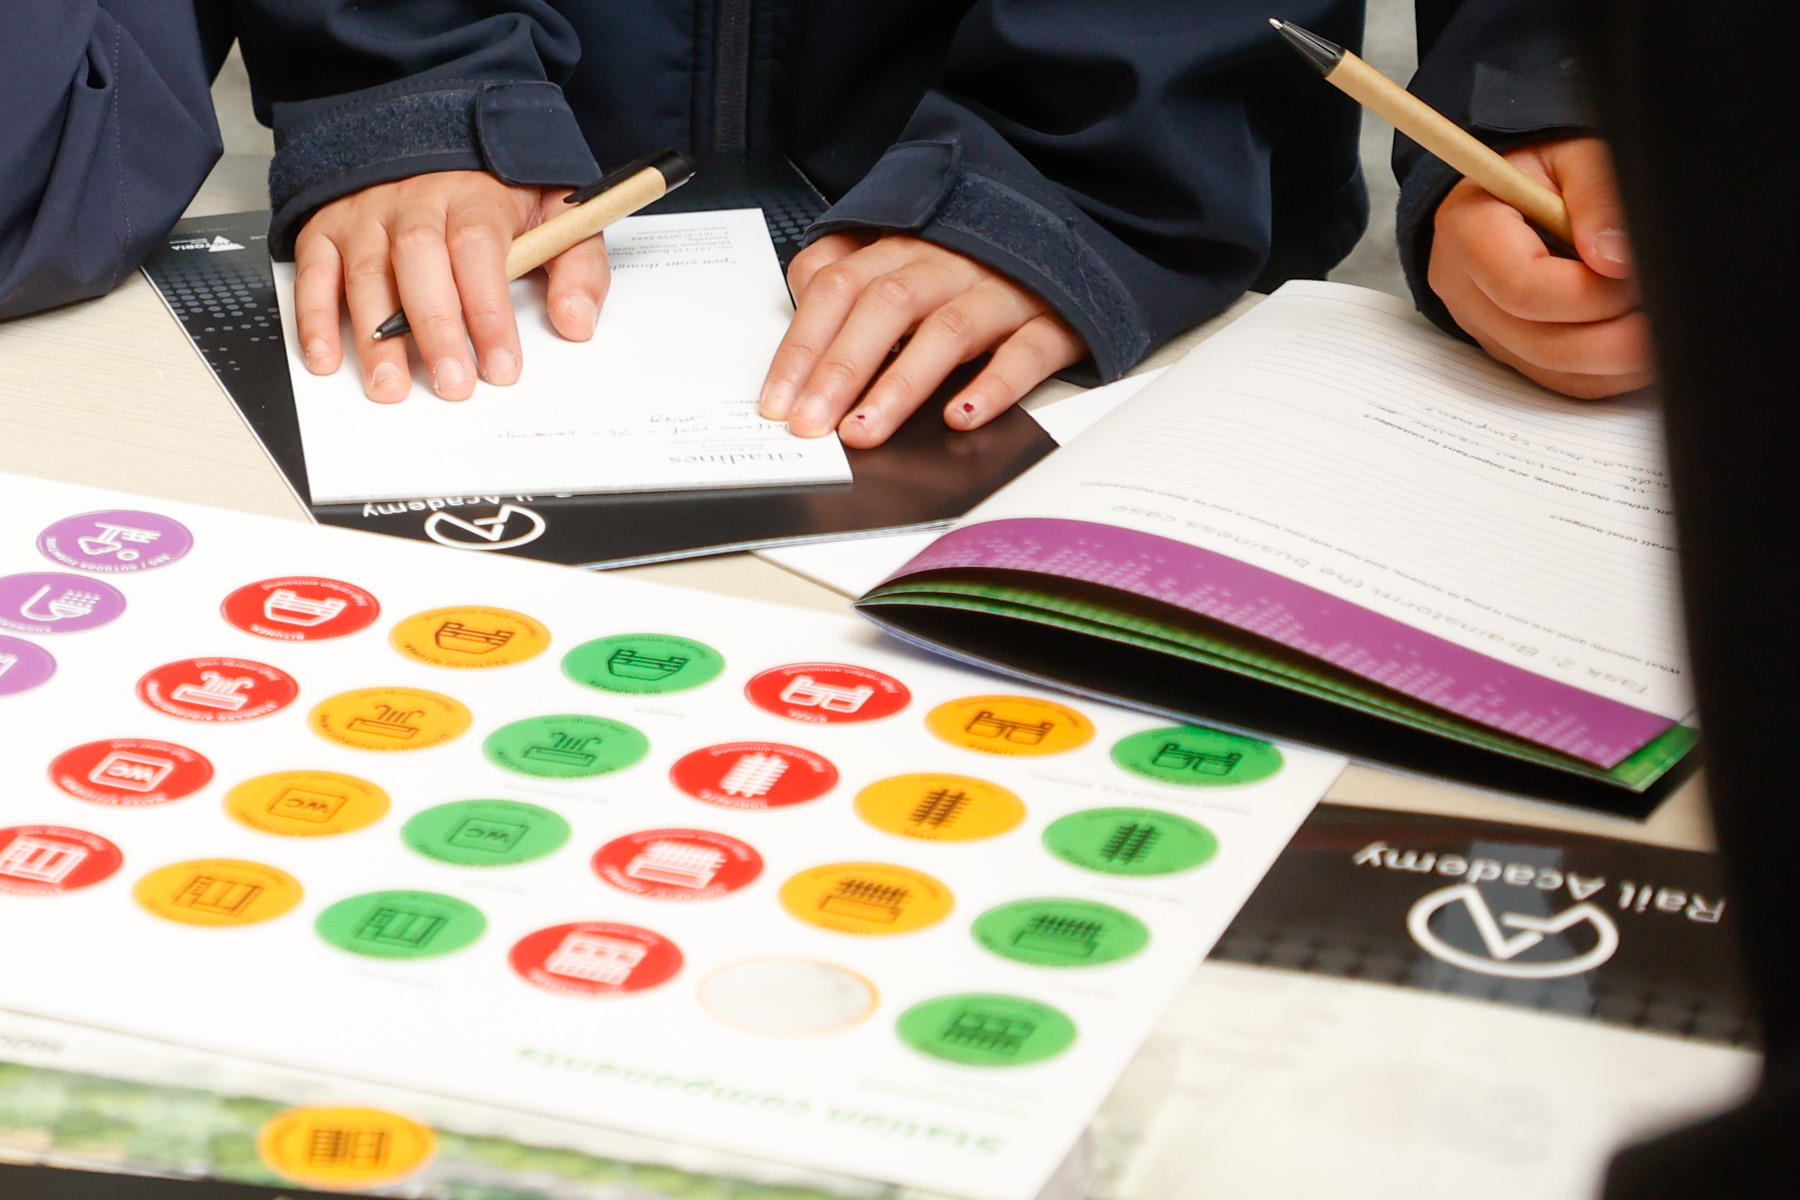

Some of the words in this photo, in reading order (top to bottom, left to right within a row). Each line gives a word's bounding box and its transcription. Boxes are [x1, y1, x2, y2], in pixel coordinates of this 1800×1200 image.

[668, 453, 804, 466] citadines
[1441, 444, 1507, 472] important
[1508, 468, 1531, 480] are
[1580, 490, 1611, 503] than
[1112, 505, 1177, 524] case
[1183, 520, 1311, 570] business
[1607, 530, 1639, 543] total
[1318, 567, 1367, 592] the
[1446, 591, 1461, 601] to
[1463, 596, 1504, 618] trying
[1372, 587, 1543, 659] Brainstorm
[1504, 612, 1531, 627] you
[1531, 623, 1554, 636] are
[1589, 643, 1643, 665] specific
[1585, 667, 1649, 697] Task
[108, 763, 154, 783] WC
[284, 797, 333, 817] WC
[463, 826, 512, 846] WC
[1352, 841, 1608, 903] Academy
[1619, 880, 1726, 925] Rail
[516, 1047, 815, 1121] components
[826, 1106, 1005, 1157] Station
